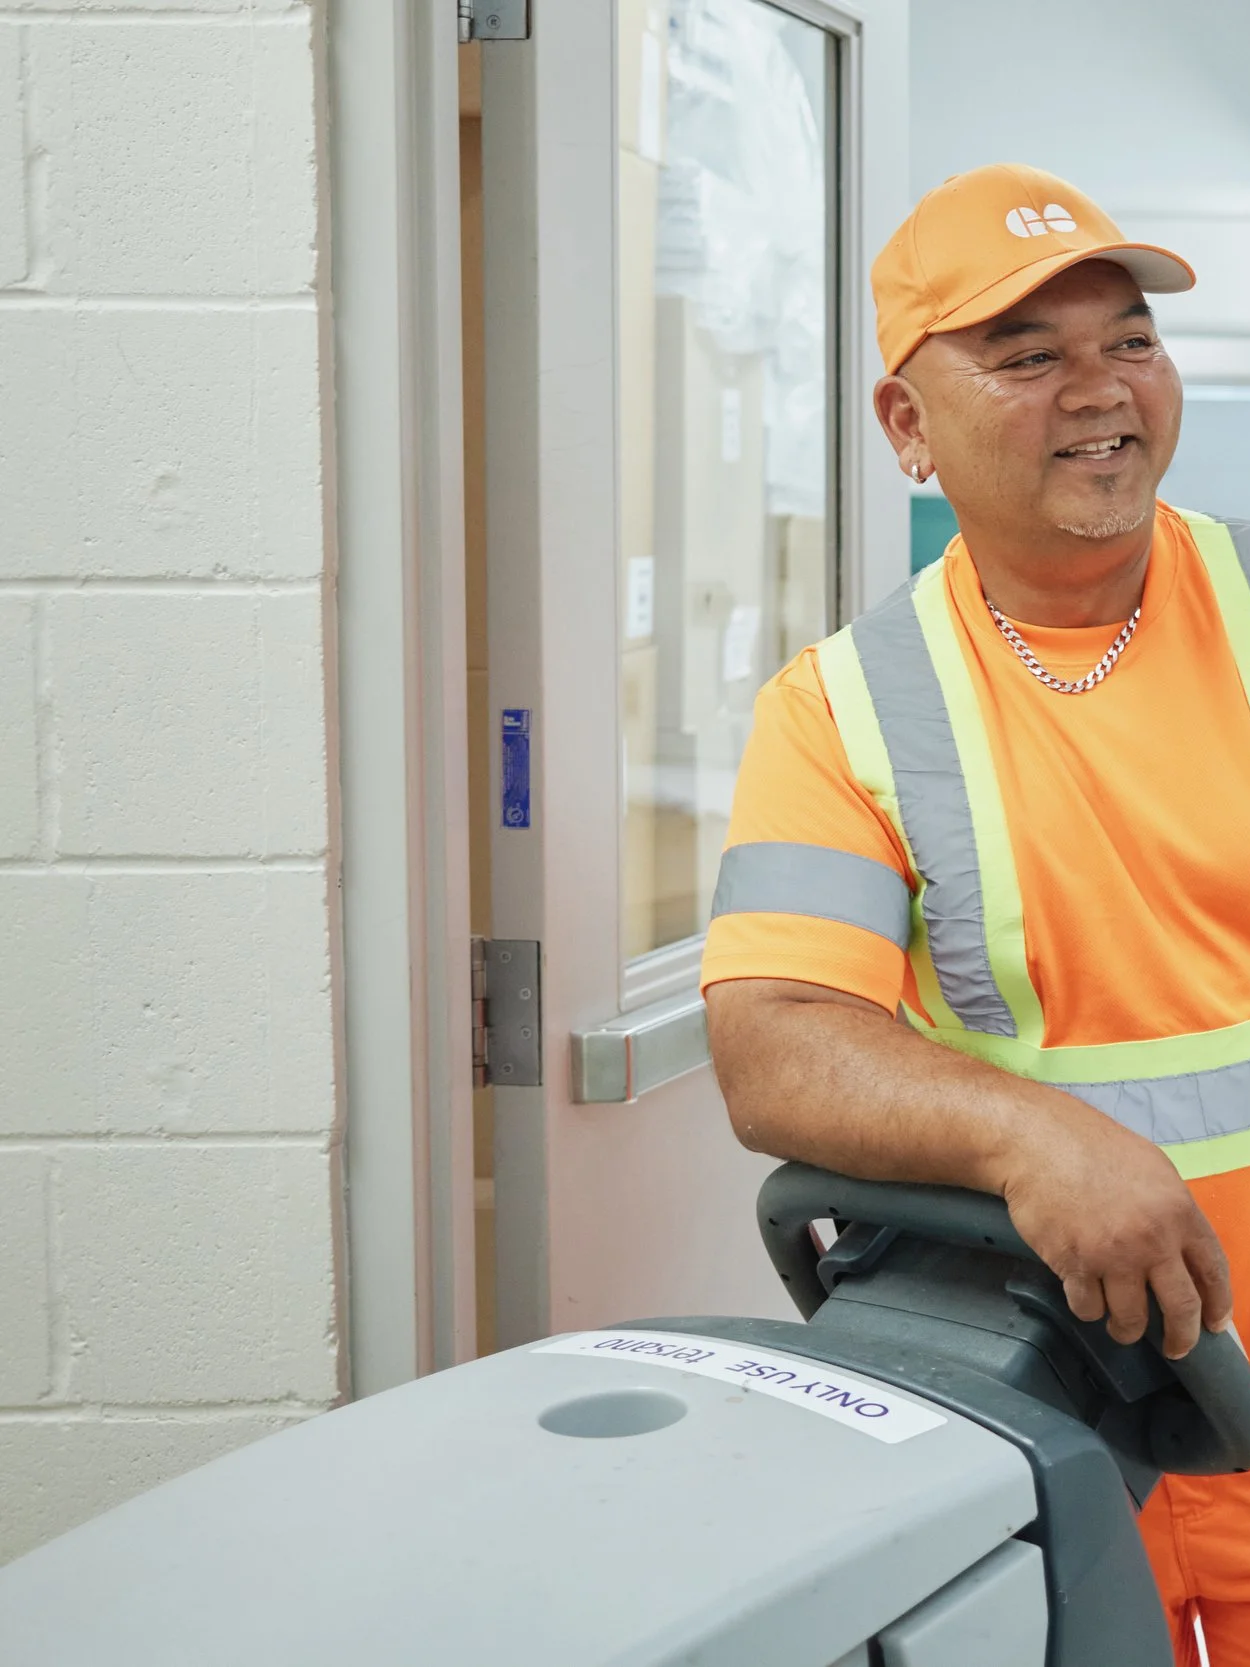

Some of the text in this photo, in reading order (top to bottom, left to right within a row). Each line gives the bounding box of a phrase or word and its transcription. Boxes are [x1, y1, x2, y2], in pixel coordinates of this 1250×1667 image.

[593, 1338, 889, 1418] ONLY USE tersano
